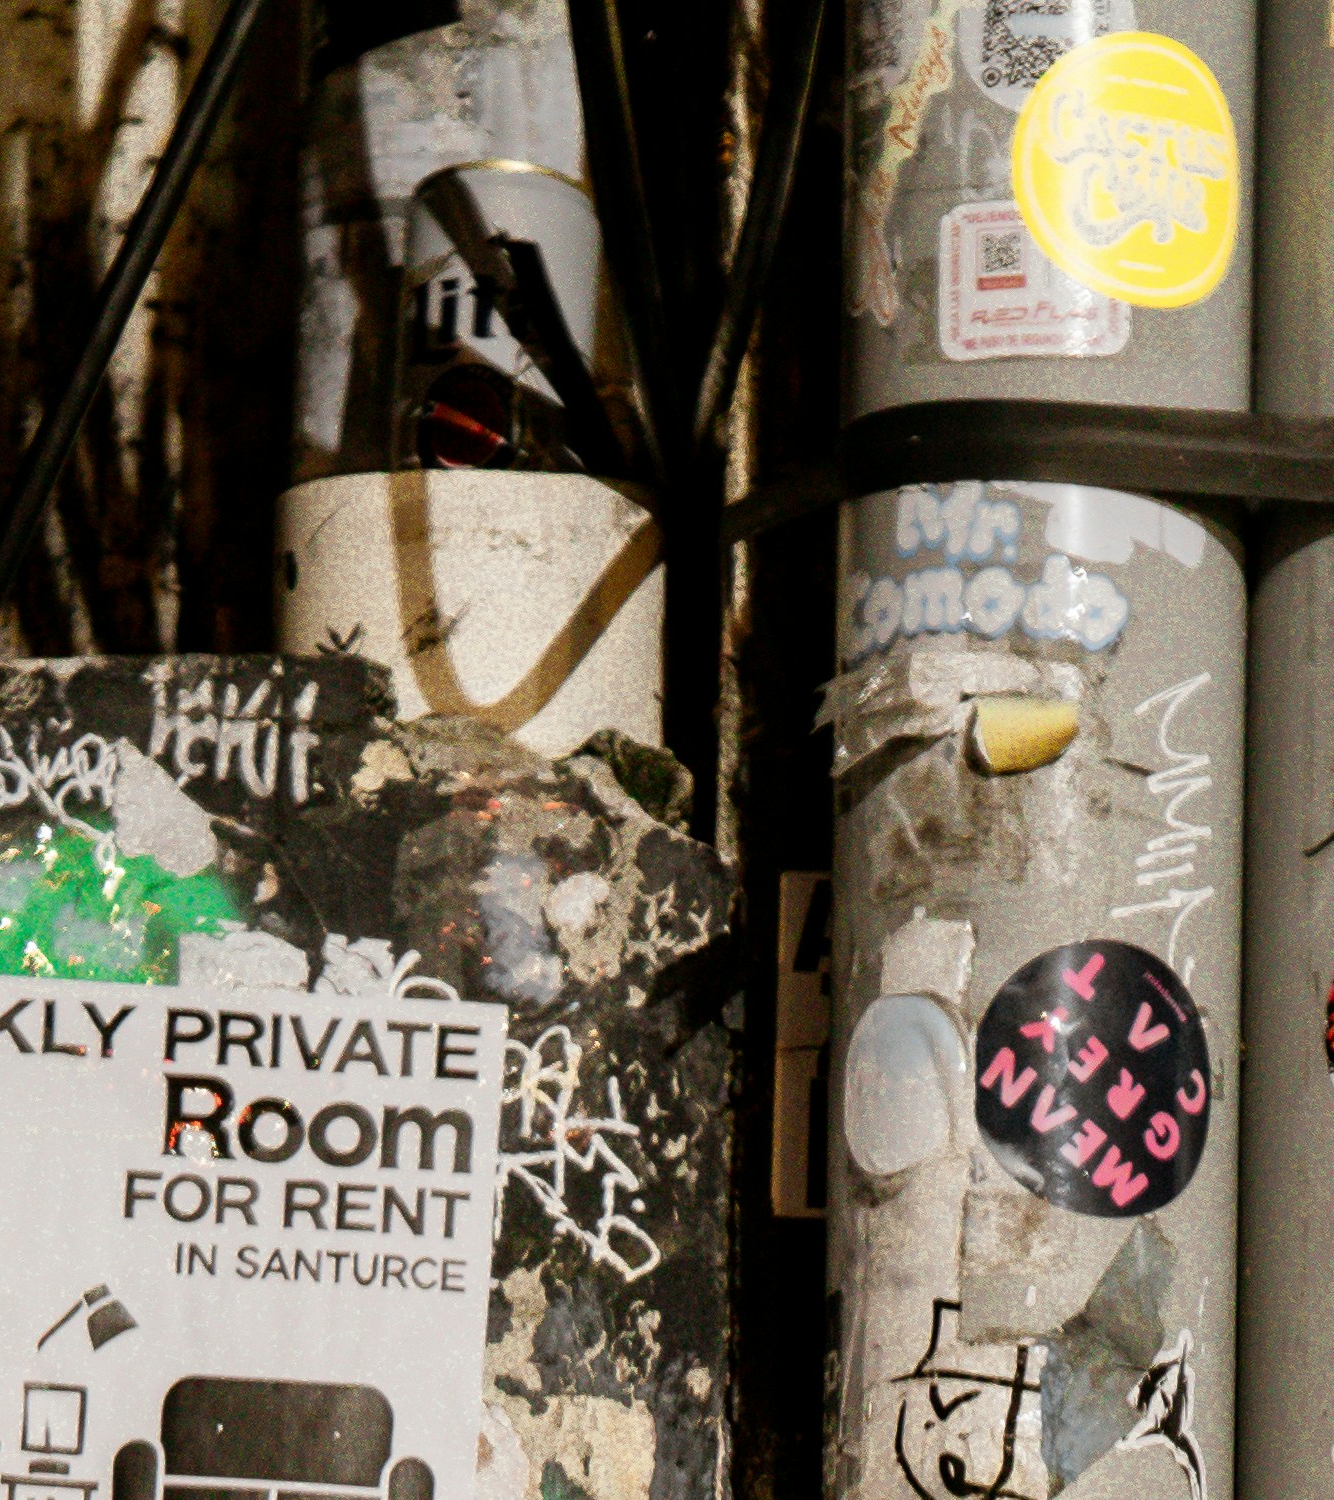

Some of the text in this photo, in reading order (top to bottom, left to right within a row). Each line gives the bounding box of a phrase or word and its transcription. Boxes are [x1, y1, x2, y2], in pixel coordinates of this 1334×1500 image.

[161, 1007, 483, 1082] PRIVATE
[161, 1072, 472, 1174] Room
[123, 1169, 471, 1239] FOR RENT
[175, 1240, 468, 1293] IN SANTURCE
